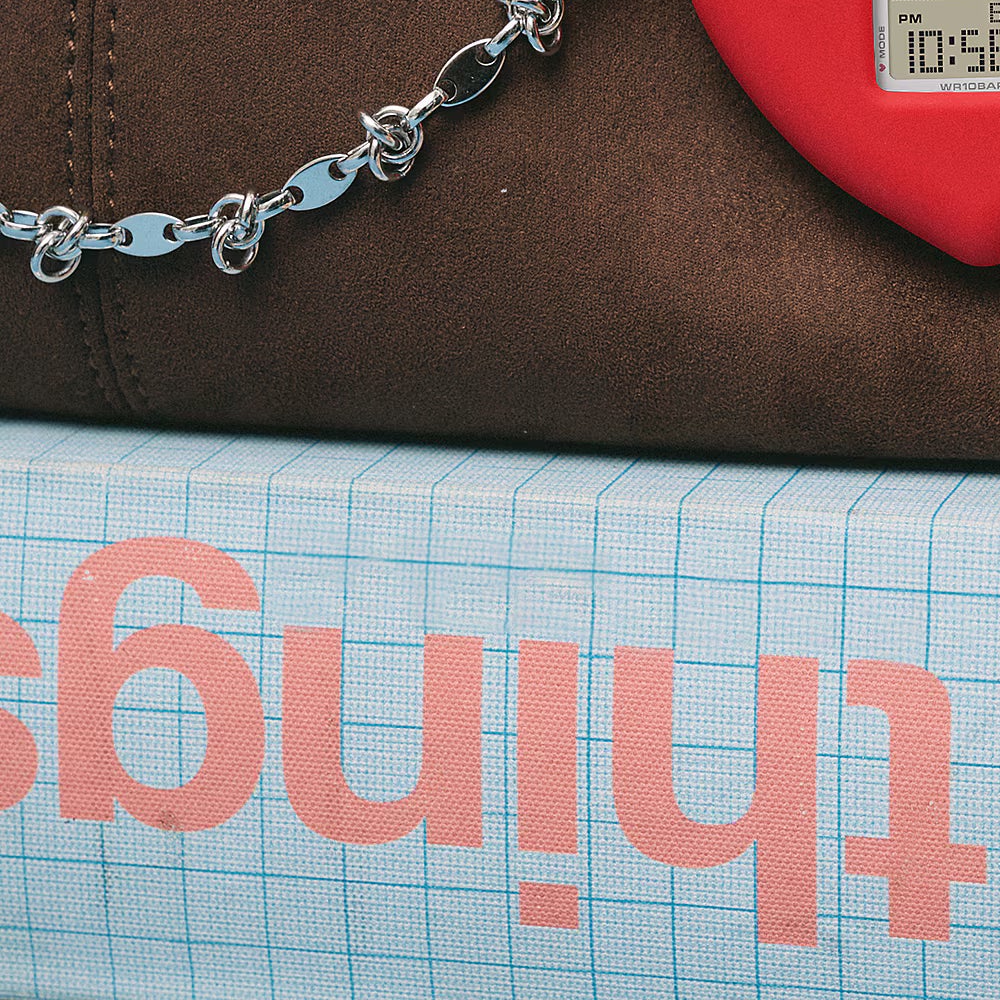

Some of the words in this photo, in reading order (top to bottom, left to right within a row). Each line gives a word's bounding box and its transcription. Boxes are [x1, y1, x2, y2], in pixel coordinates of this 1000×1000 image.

[898, 14, 922, 24] PM
[878, 26, 886, 58] MODE
[0, 536, 987, 947] thing
